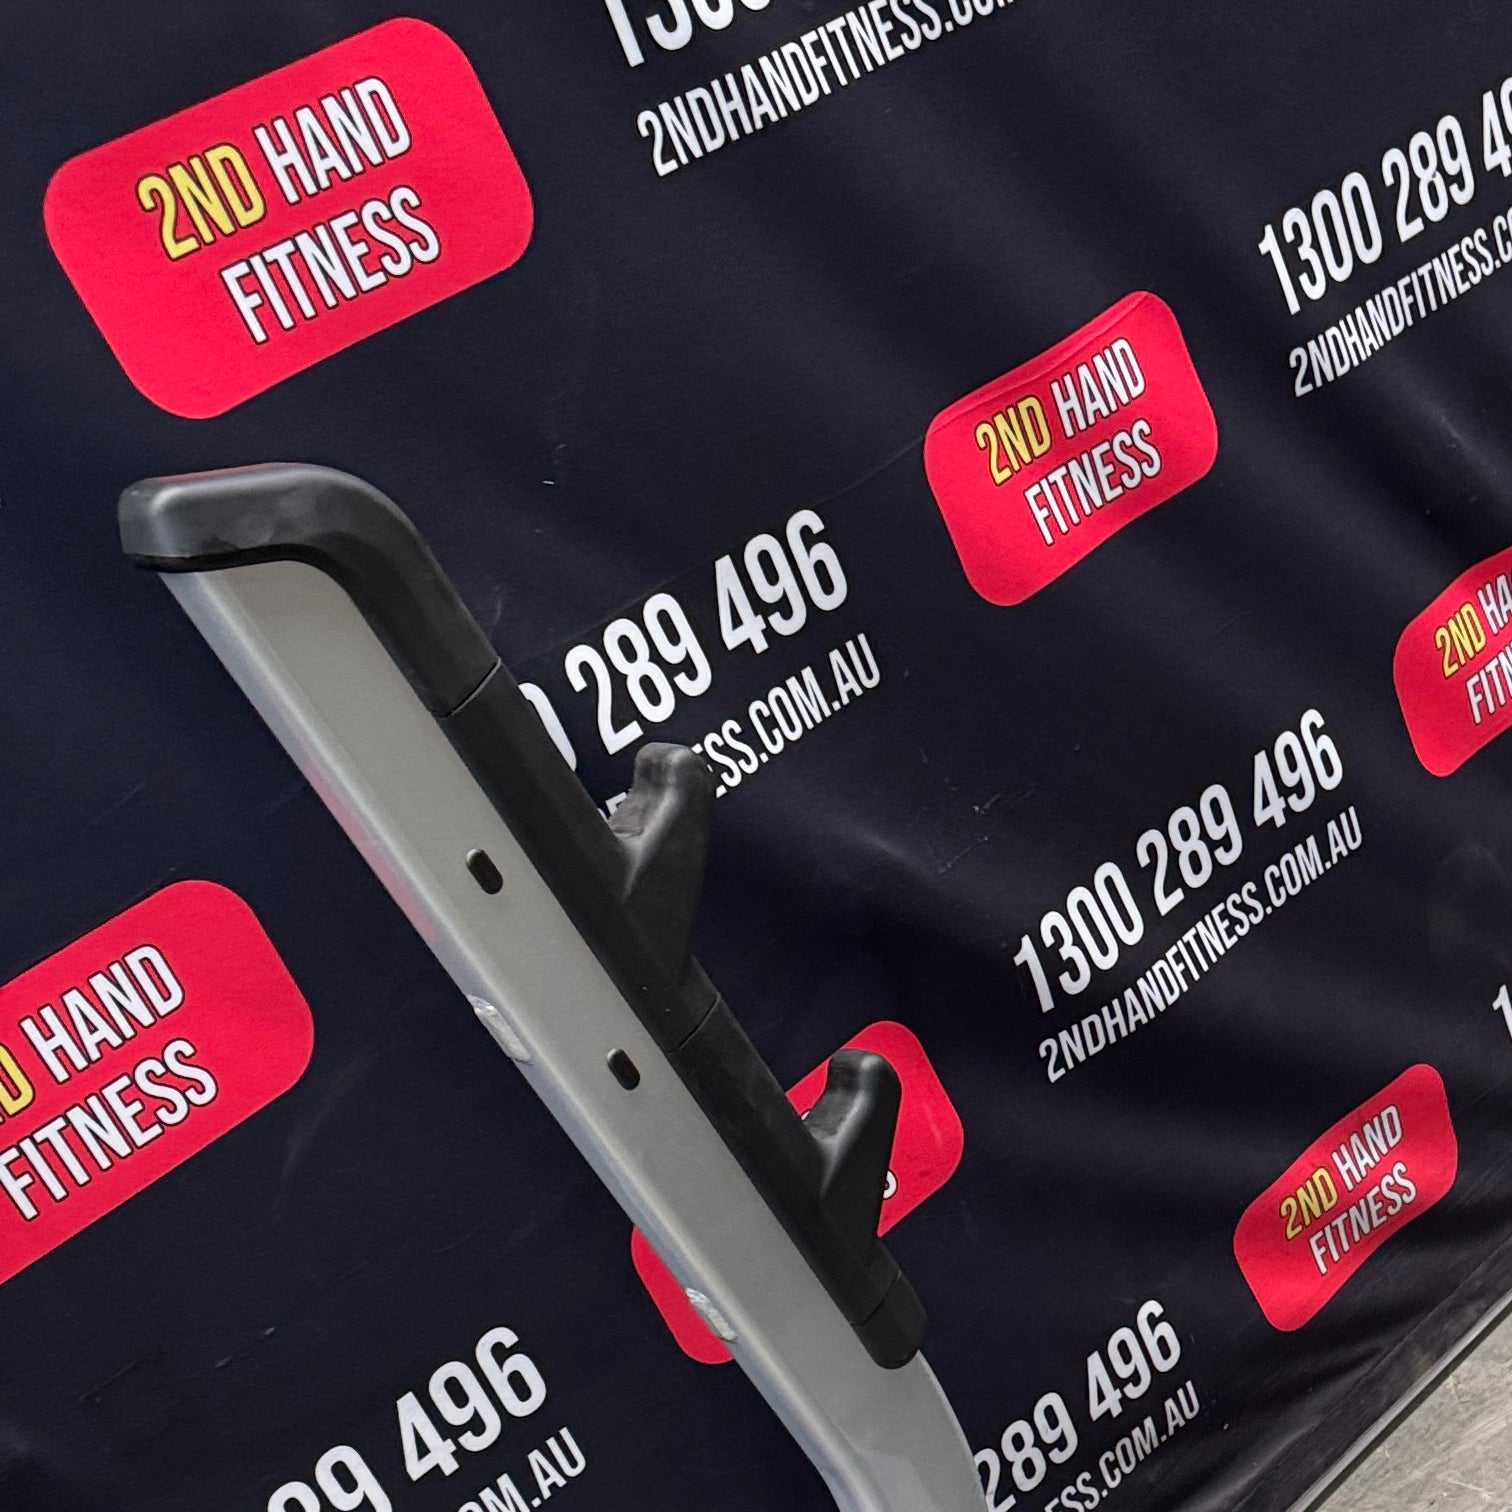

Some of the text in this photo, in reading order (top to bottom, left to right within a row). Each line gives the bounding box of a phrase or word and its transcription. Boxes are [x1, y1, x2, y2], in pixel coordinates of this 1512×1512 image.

[138, 77, 412, 260] 2ND HAND
[1258, 171, 1383, 315] 1300
[1381, 114, 1475, 243] 289
[221, 186, 441, 343] FITNESS
[976, 337, 1146, 486] 2ND HAND
[1024, 420, 1162, 546] FITNESS
[565, 592, 712, 756] 289
[715, 509, 848, 654] 496
[1434, 601, 1486, 678] 2ND
[1013, 708, 1343, 1014] 1300 289 496
[20, 944, 184, 1083] HAND
[1038, 806, 1363, 1083] 2NDHANDFITNESS.COM.AU
[0, 1039, 218, 1221] FITNESS
[1279, 1104, 1402, 1240] 2ND HAND
[1308, 1161, 1416, 1276] FITNESS
[396, 1327, 547, 1482] 496
[1087, 1300, 1181, 1422] 496
